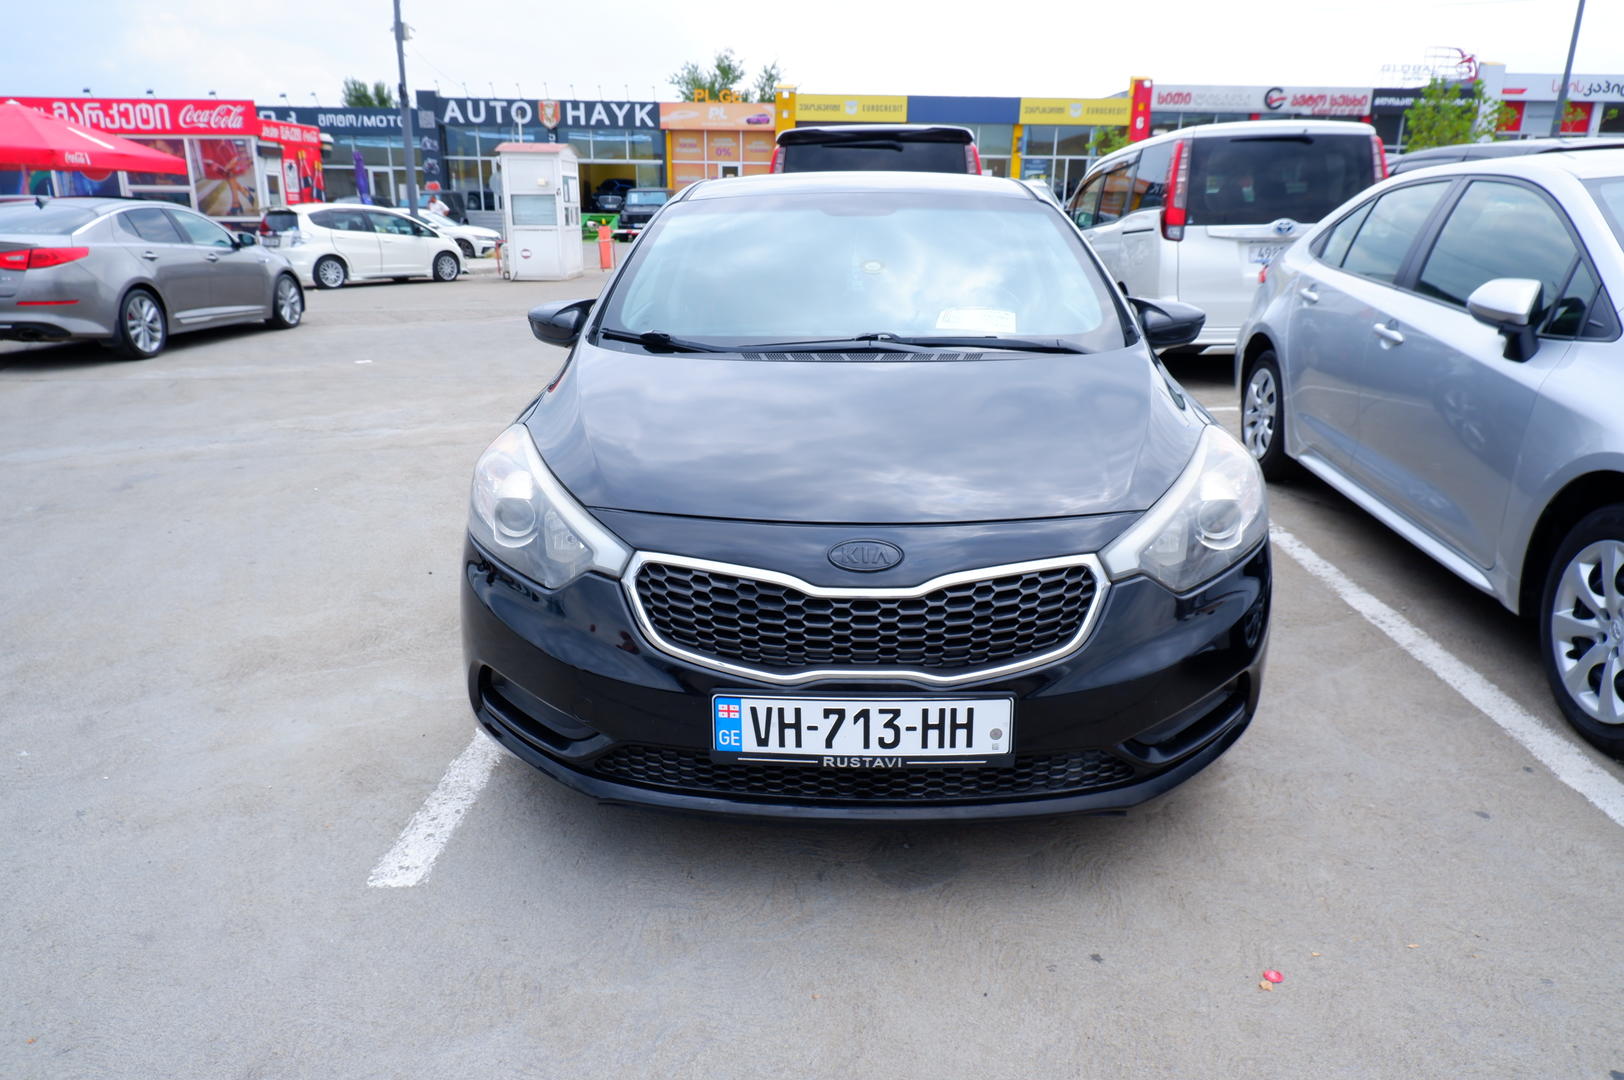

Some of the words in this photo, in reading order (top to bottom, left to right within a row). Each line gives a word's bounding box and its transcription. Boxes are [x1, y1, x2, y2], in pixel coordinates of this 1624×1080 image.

[178, 104, 245, 129] Coca-Cola
[443, 100, 533, 124] AUTO
[566, 102, 655, 127] HAYK
[841, 546, 890, 565] KIA
[718, 729, 741, 746] GE
[749, 706, 975, 750] VH-713-HH
[822, 756, 902, 768] RUSTAVI
